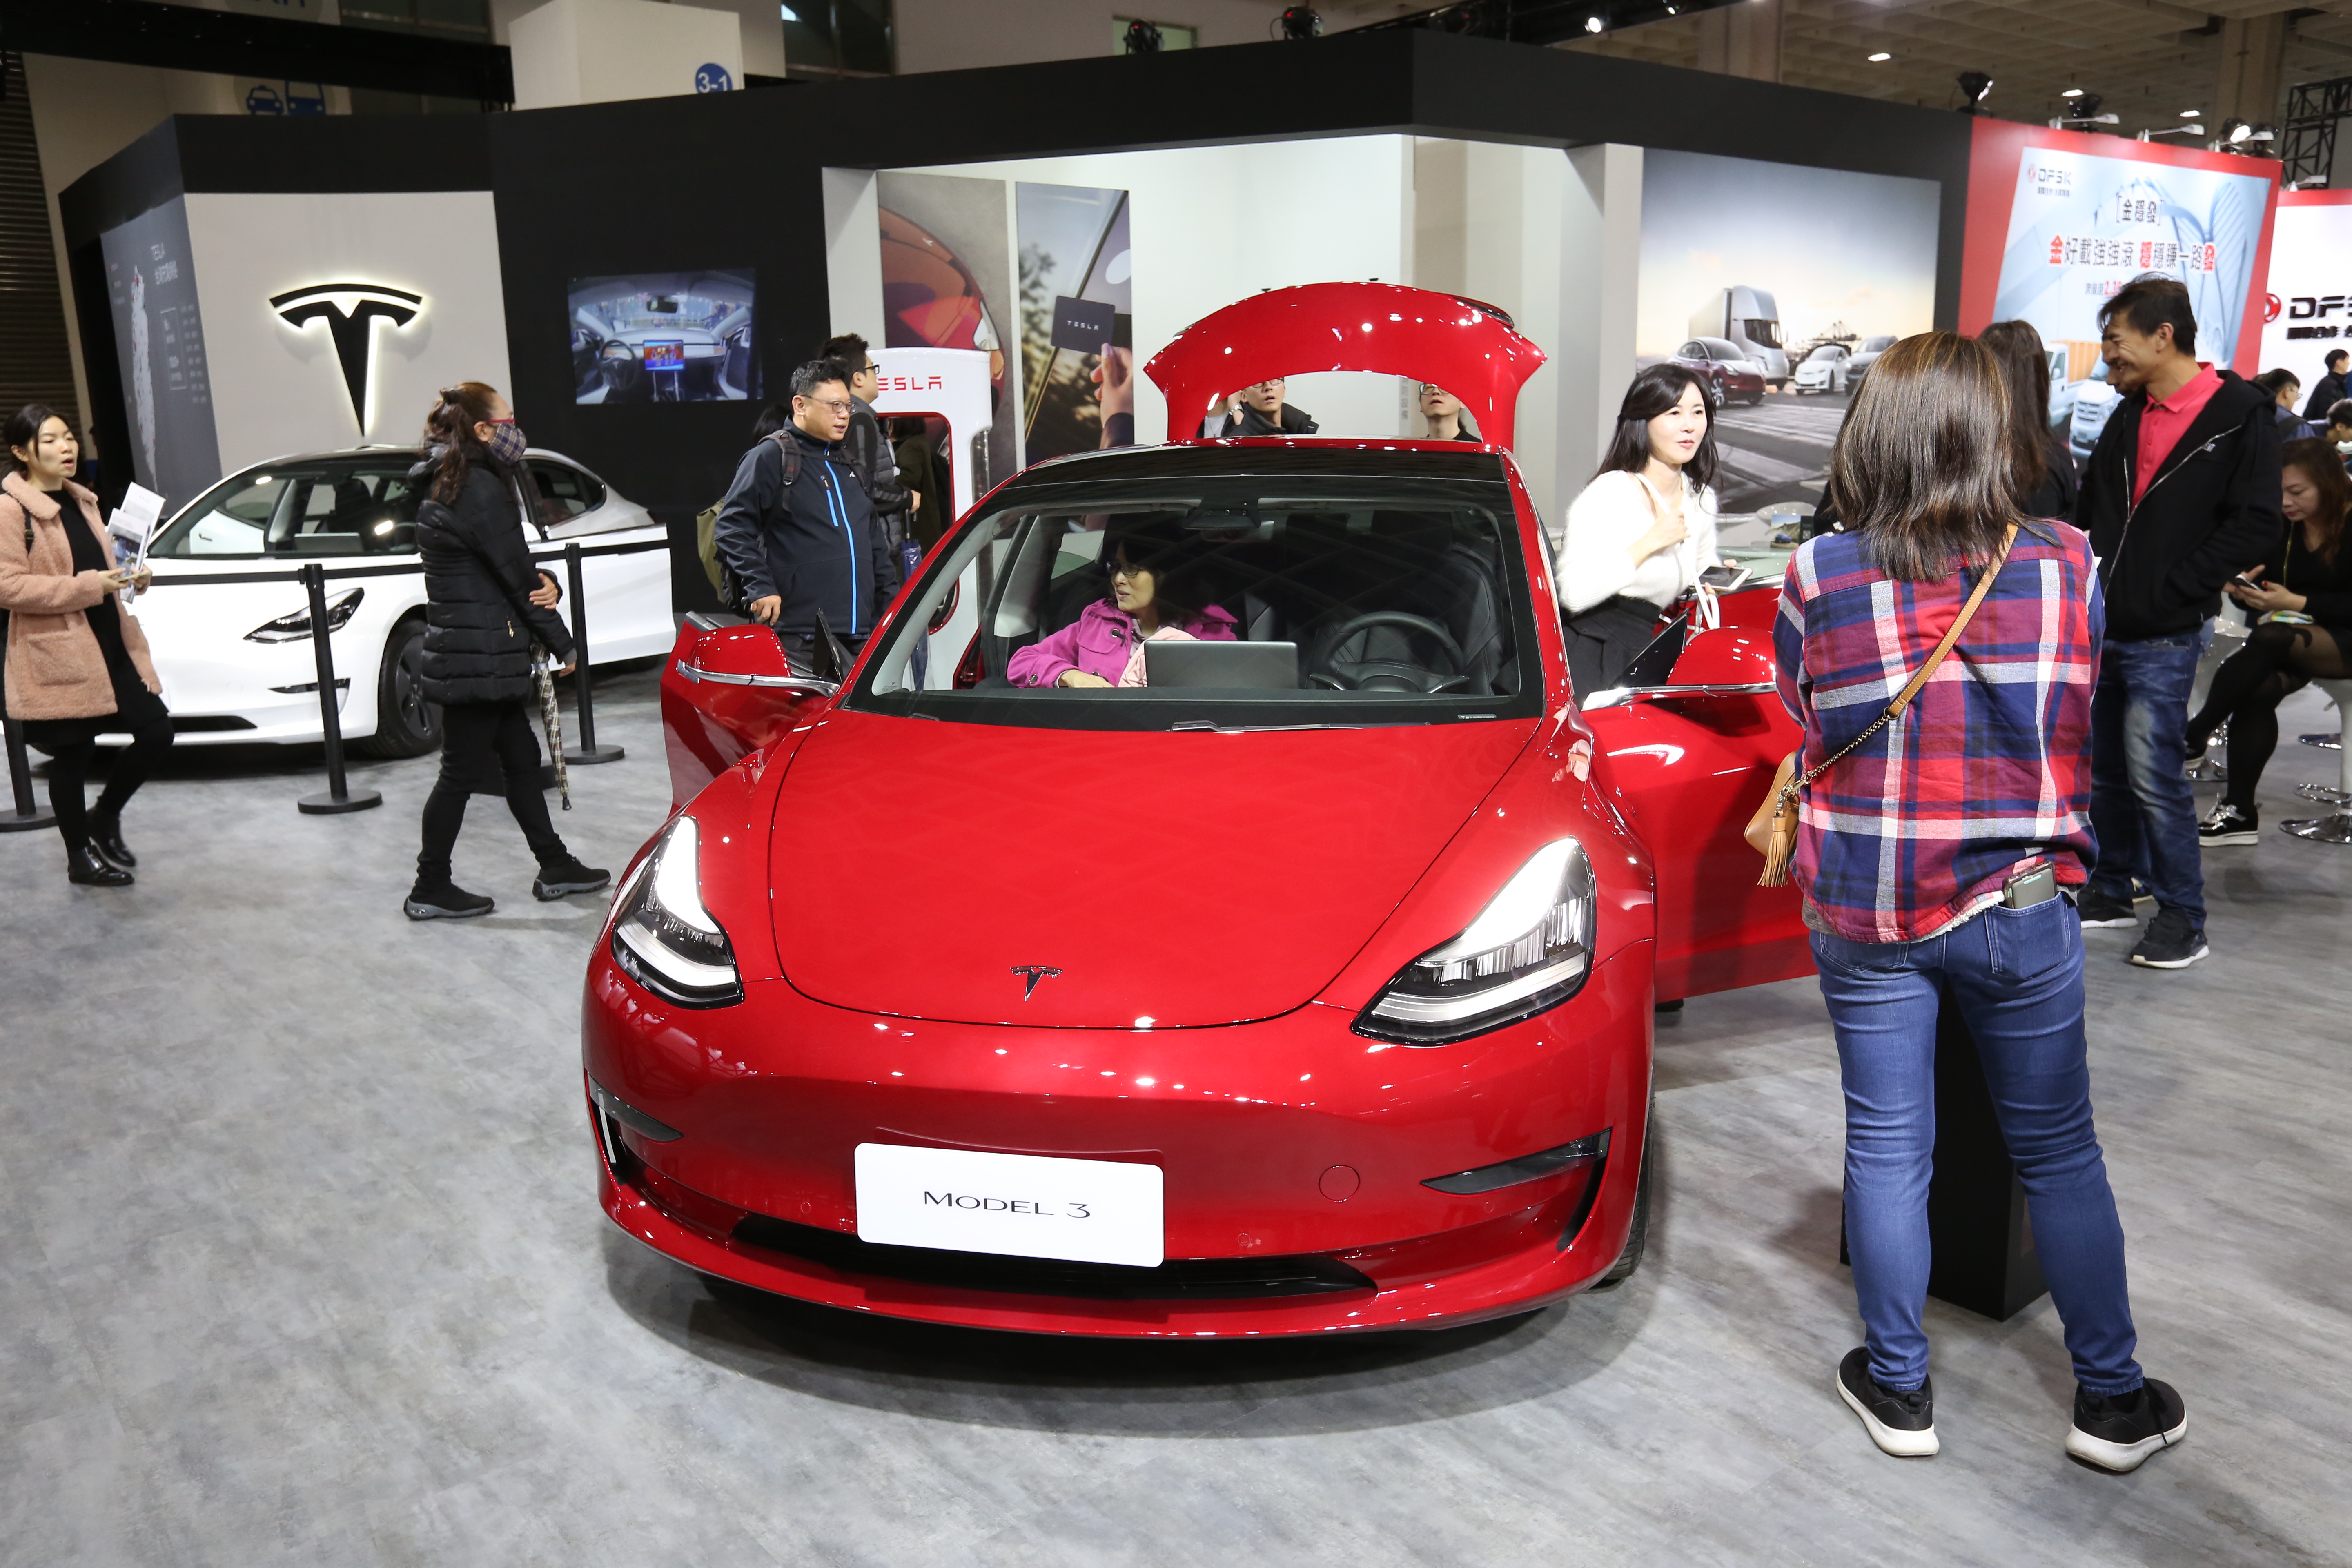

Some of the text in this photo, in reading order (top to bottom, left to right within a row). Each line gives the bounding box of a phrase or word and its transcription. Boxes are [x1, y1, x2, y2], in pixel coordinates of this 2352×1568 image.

[697, 72, 728, 93] 3-1
[2038, 168, 2072, 185] DFSK
[1067, 320, 1099, 331] TESLA
[877, 376, 942, 391] ESLA
[924, 1191, 1091, 1218] MODEL 3
